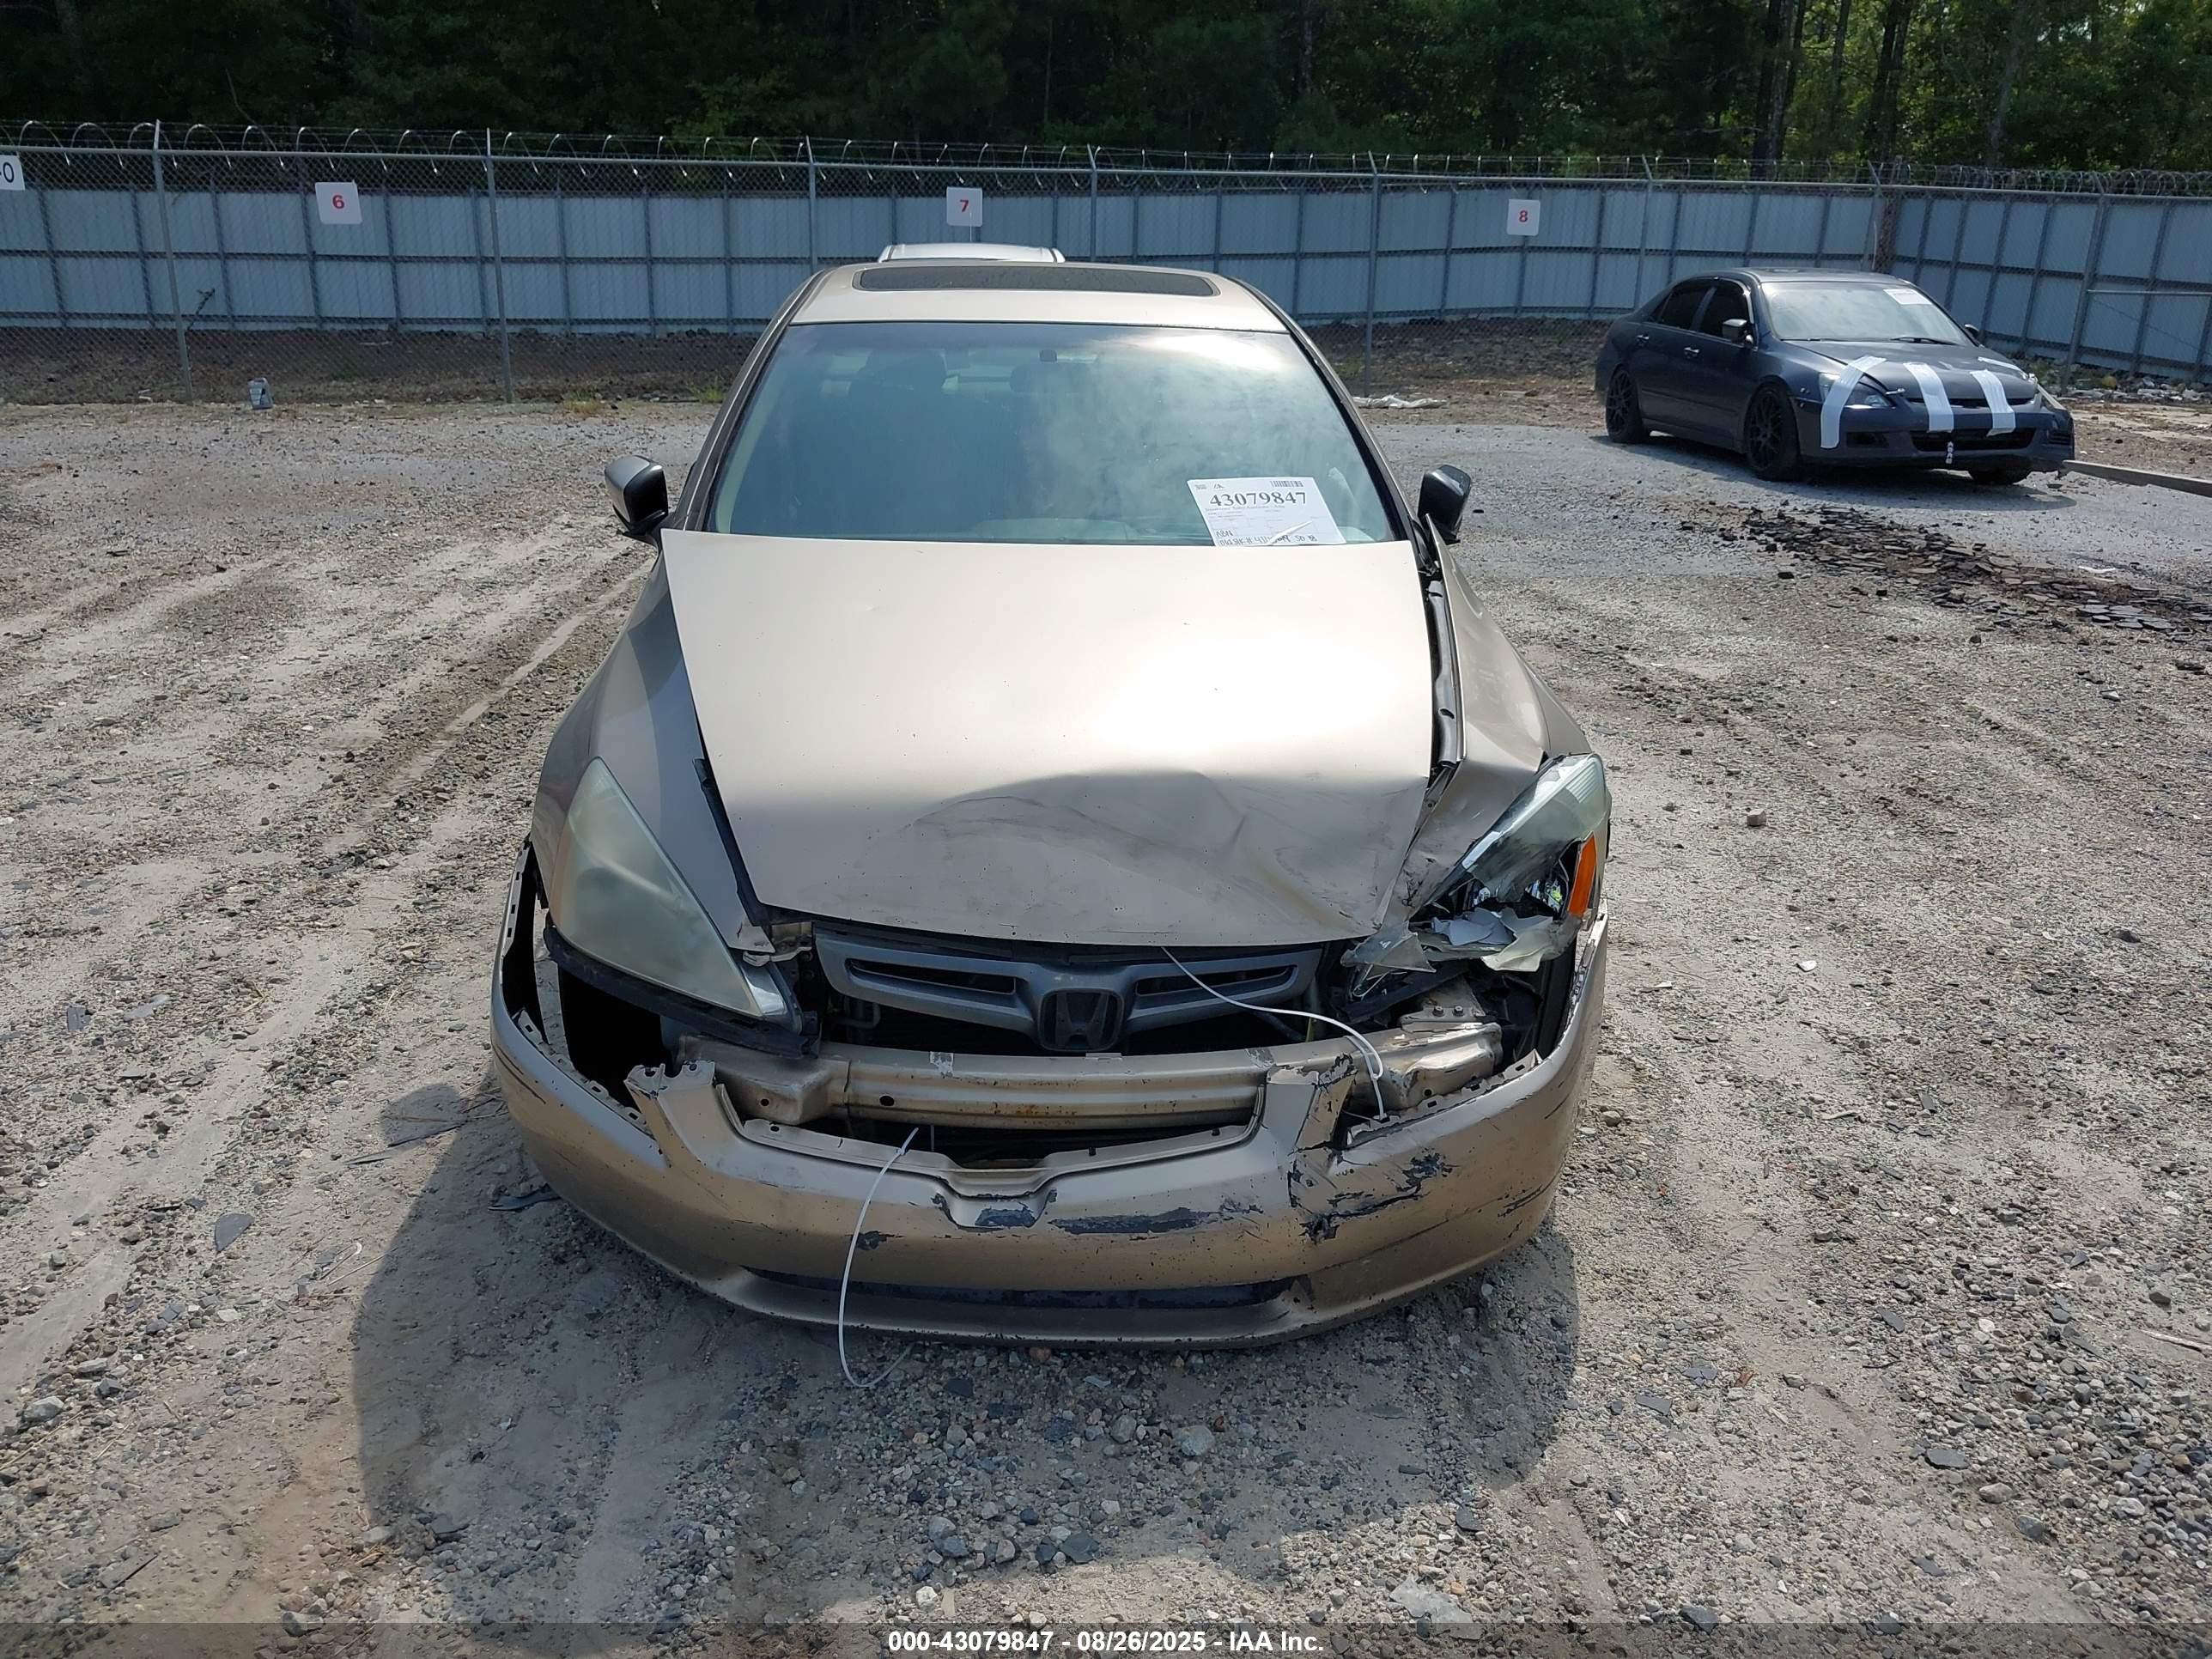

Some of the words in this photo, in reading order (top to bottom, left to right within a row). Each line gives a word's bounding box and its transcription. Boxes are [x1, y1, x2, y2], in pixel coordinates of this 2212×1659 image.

[332, 194, 345, 210] 6
[959, 199, 969, 213] 7
[1519, 210, 1528, 222] 8
[1209, 491, 1306, 507] 43079847
